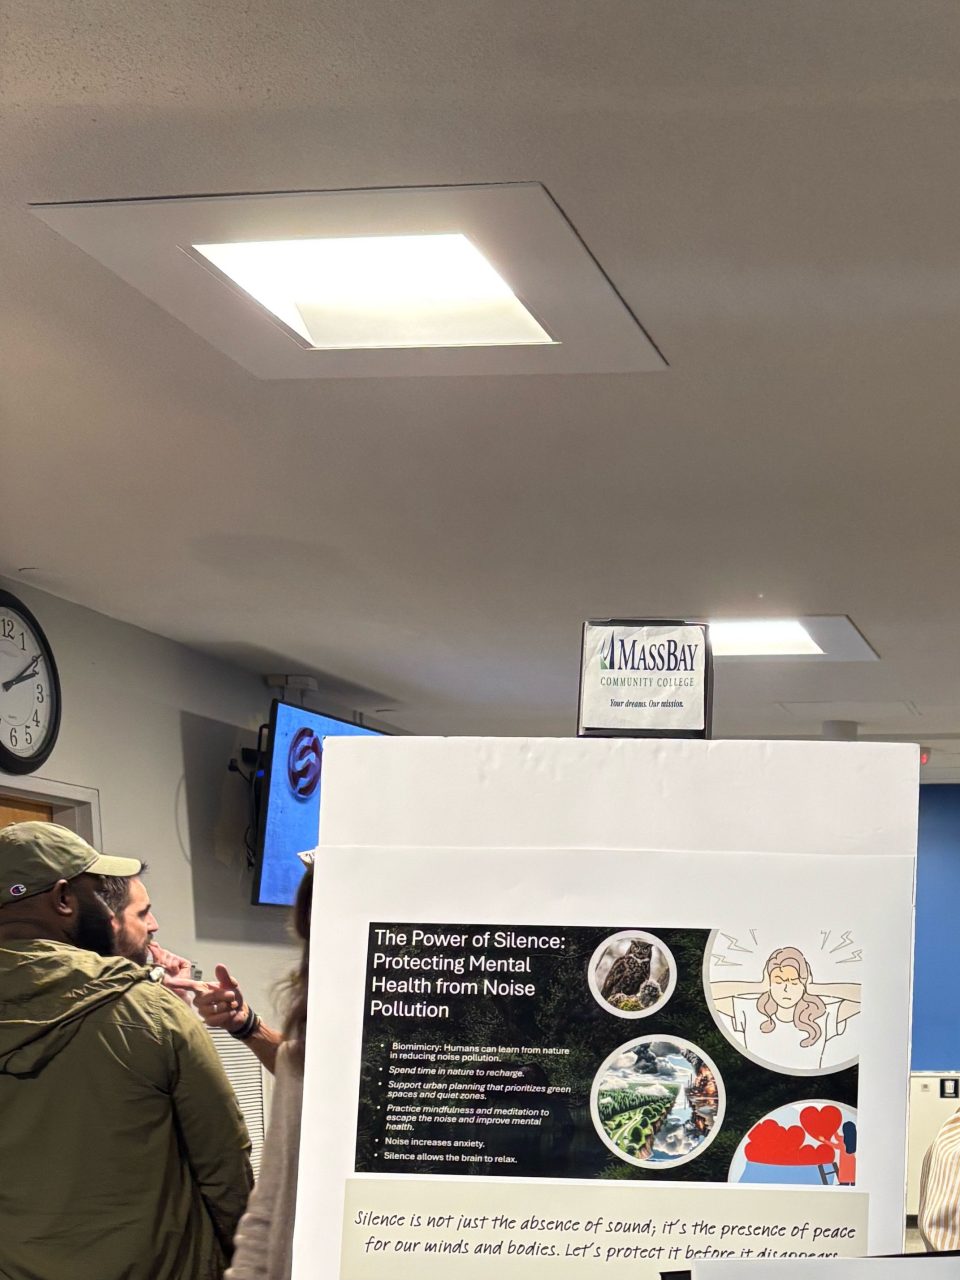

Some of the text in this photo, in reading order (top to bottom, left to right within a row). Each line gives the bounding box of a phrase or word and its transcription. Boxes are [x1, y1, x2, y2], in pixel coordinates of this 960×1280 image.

[1, 618, 15, 640] 12
[600, 677, 695, 688] COMMUNITY COLLEGE
[36, 684, 44, 703] 3
[610, 699, 624, 707] Your
[648, 699, 660, 708] Our
[32, 709, 40, 727] 4
[10, 727, 18, 747] 6
[25, 725, 33, 744] 5
[374, 929, 565, 949] The Power of Silence:
[373, 953, 531, 974] Protecting Mental
[372, 976, 535, 996] Health from Noise
[370, 1000, 449, 1018] Pollution
[392, 1042, 442, 1052] Biomimicry:
[444, 1044, 480, 1053] Humans
[498, 1045, 520, 1053] learn
[521, 1046, 541, 1054] from
[542, 1047, 570, 1055] nature
[390, 1051, 502, 1063] in reducing noise pollution.
[388, 1065, 417, 1075] Spend
[417, 1066, 436, 1075] time
[437, 1067, 446, 1075] in
[447, 1068, 475, 1076] nature
[486, 1069, 524, 1078] recharge.
[388, 1080, 422, 1090] Support
[422, 1081, 448, 1090] urban
[448, 1082, 486, 1092] planning
[504, 1084, 546, 1092] prioritizes
[546, 1086, 572, 1094] green
[387, 1091, 418, 1099] spaces
[419, 1090, 437, 1098] and
[436, 1092, 459, 1100] quiet
[386, 1104, 421, 1113] Practice
[422, 1105, 474, 1114] mindfulness
[475, 1107, 493, 1115] and
[493, 1108, 539, 1116] meditation
[385, 1122, 414, 1131] health.
[386, 1115, 417, 1123] escape
[418, 1114, 432, 1122] the
[433, 1115, 457, 1123] noise
[476, 1116, 510, 1125] improve
[385, 1137, 485, 1149] Noise increases anxiety.
[384, 1151, 415, 1160] Silence
[416, 1153, 444, 1161] allows
[445, 1154, 460, 1162] the
[461, 1154, 483, 1162] brain
[494, 1155, 517, 1163] relax.
[354, 1210, 856, 1242] Silence is not just the absence of sound; it's the presence of peace
[365, 1236, 391, 1253] for
[394, 1240, 421, 1252] our
[424, 1239, 469, 1254] minds
[474, 1240, 504, 1255] and
[507, 1240, 560, 1256] bodies.
[565, 1242, 601, 1258] Let's
[606, 1246, 665, 1262] protect
[668, 1246, 682, 1260] it
